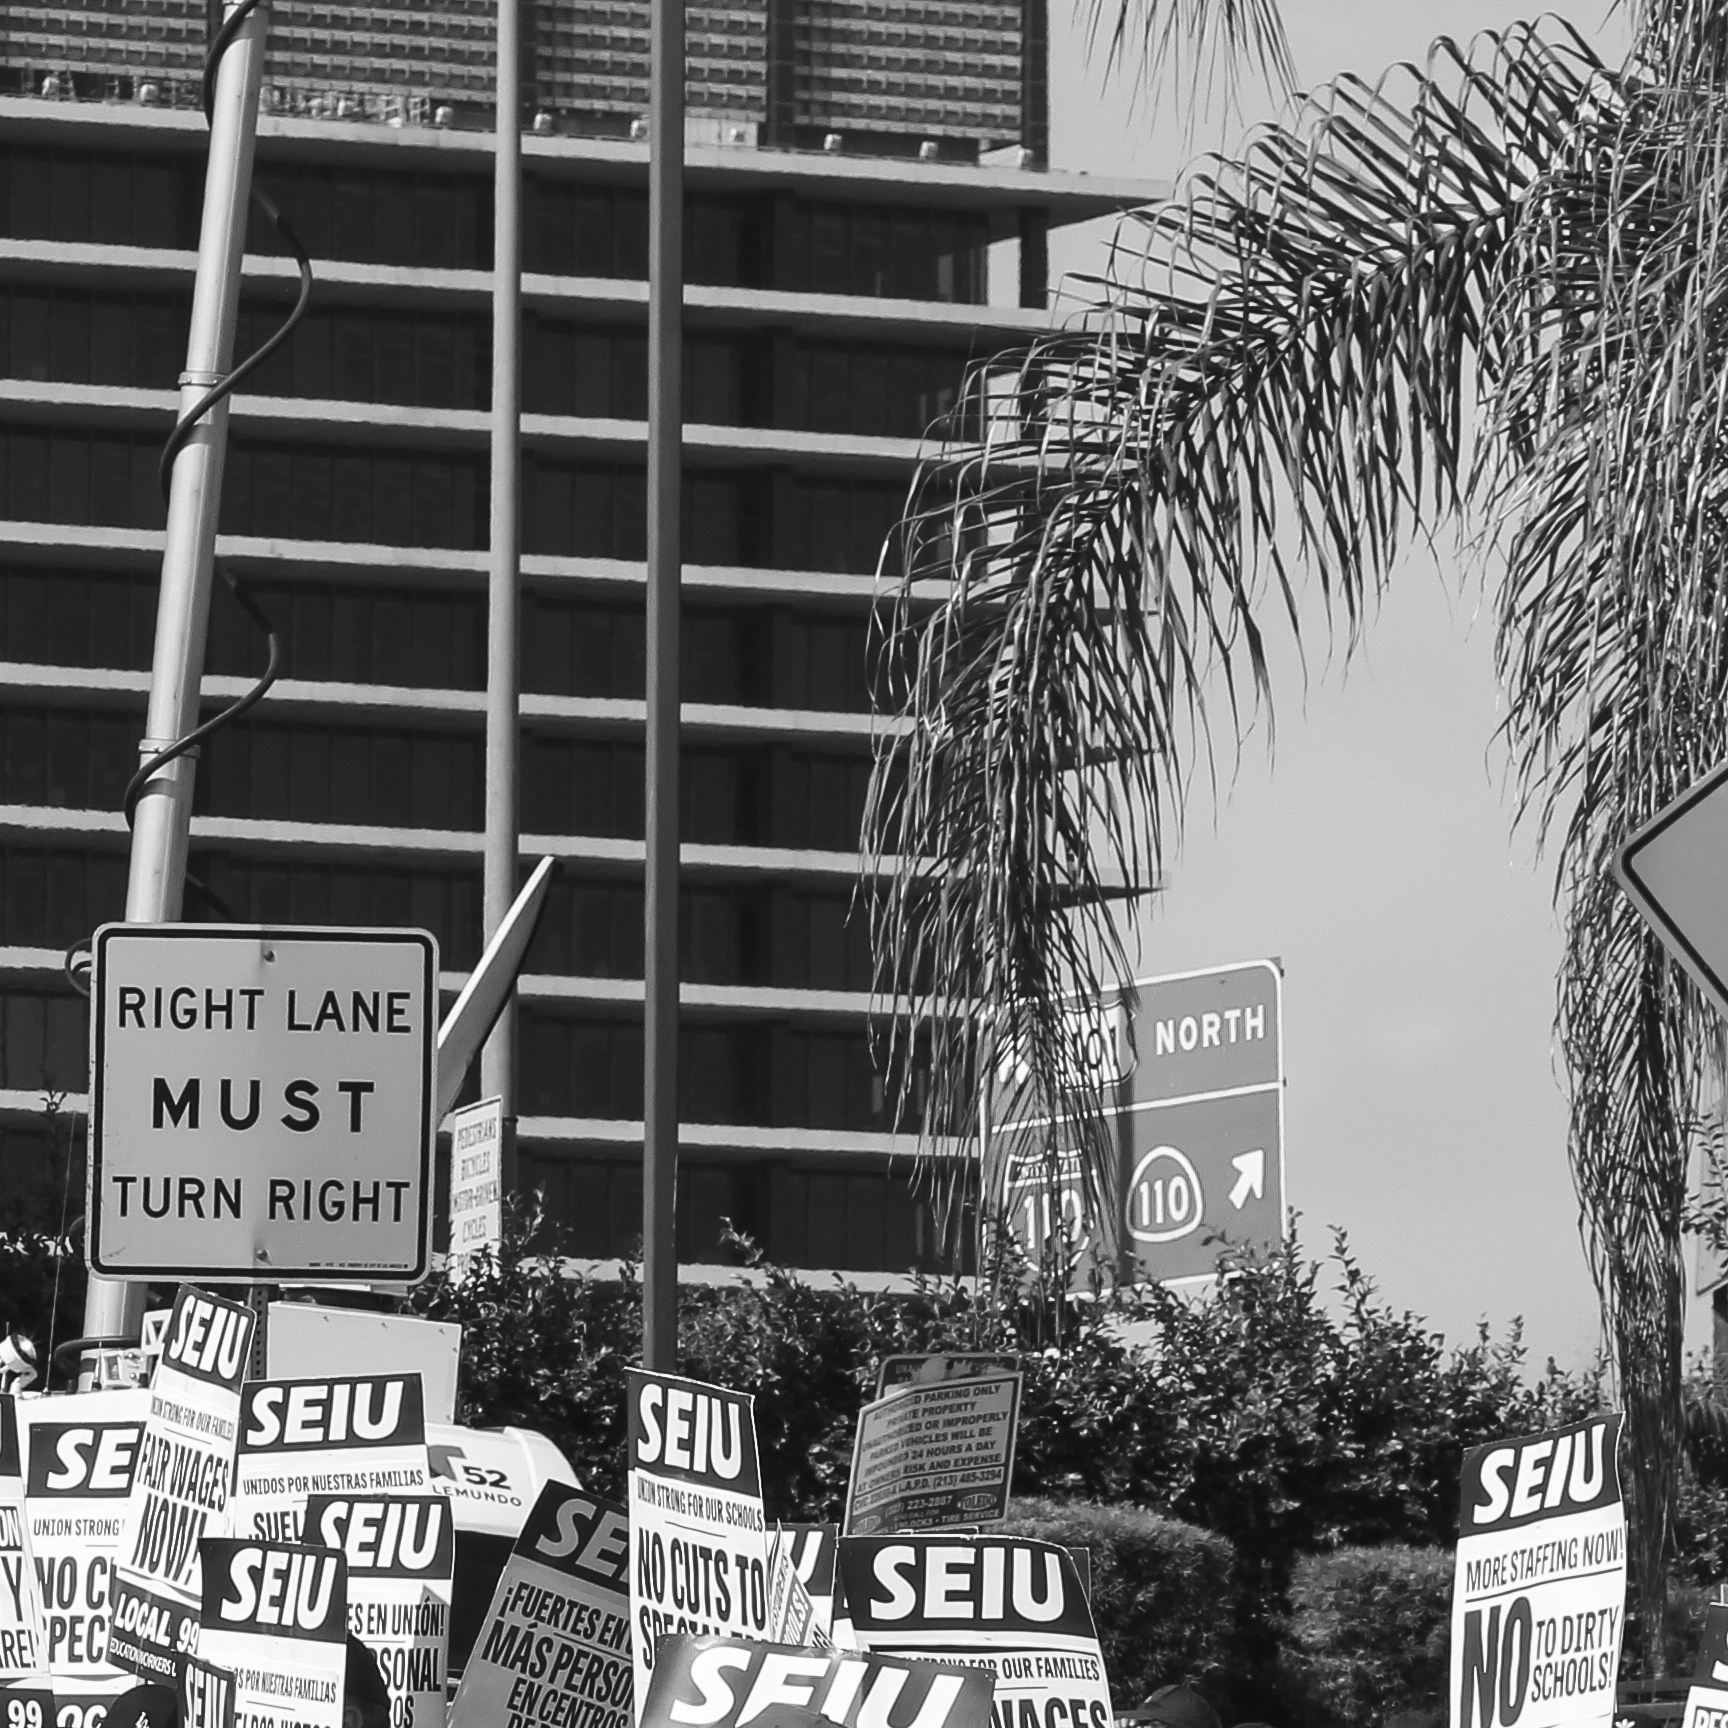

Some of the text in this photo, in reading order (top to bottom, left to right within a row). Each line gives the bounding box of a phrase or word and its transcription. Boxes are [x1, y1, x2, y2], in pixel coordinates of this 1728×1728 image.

[118, 987, 412, 1033] RIGHT LANE
[1155, 1005, 1266, 1055] NORTH
[152, 1078, 375, 1134] MUST
[112, 1177, 242, 1219] TURN
[268, 1180, 411, 1224] RIGHT
[168, 1295, 249, 1379] SEIU
[245, 1378, 404, 1447] SEIU
[920, 1384, 1001, 1403] PARKING ONLY
[922, 1402, 977, 1417] PROPERTY
[637, 1383, 742, 1479] SEIU
[942, 1411, 1009, 1428] IMPROPERLY
[951, 1428, 976, 1440] WILL
[137, 1433, 229, 1512] FAIR WAGES
[242, 1470, 423, 1495] UNIDOS POR NUESTRAS FAMILIAS
[463, 1465, 513, 1491] 52
[1473, 1424, 1606, 1524] SEIU
[33, 1519, 119, 1537] UNION STRONG
[638, 1526, 766, 1632] NO CUTS TO
[870, 1545, 1066, 1623] SEIU
[1466, 1527, 1623, 1592] MORE STAFFING NOW!
[220, 1546, 338, 1630] SEIU
[114, 1590, 199, 1657] LOCAL 99
[1535, 1606, 1620, 1660] TO DIRTY
[1002, 1657, 1099, 1680] OUR FAMILIES
[1531, 1651, 1614, 1702] SCHOOLS!
[507, 1677, 538, 1718] EN
